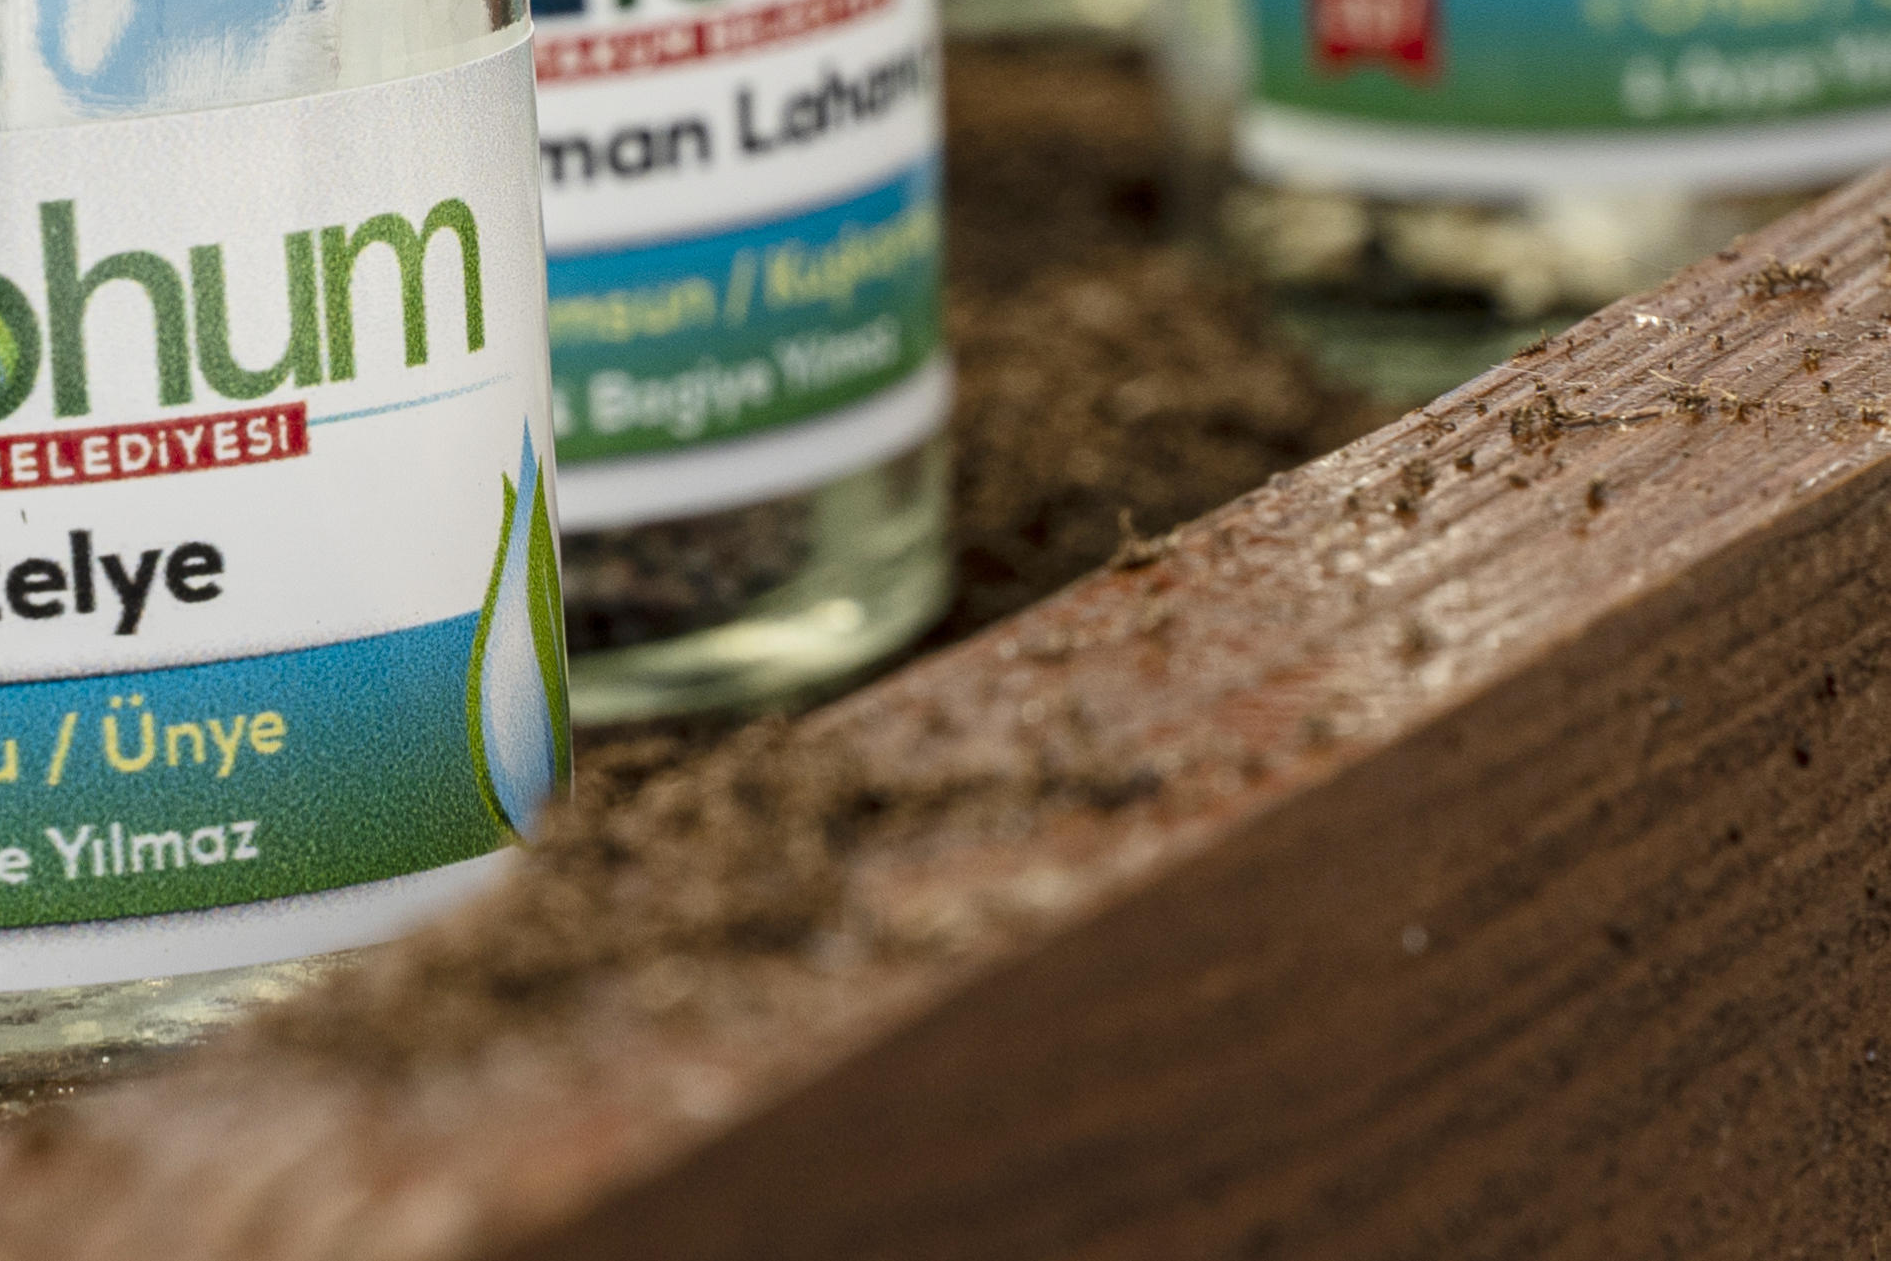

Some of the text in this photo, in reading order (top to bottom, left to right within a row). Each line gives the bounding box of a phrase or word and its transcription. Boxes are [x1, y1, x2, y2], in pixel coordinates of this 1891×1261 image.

[541, 45, 934, 182] man Lahan
[46, 712, 78, 787] /
[101, 696, 288, 780] Ünye
[45, 822, 260, 880] Yılmaz
